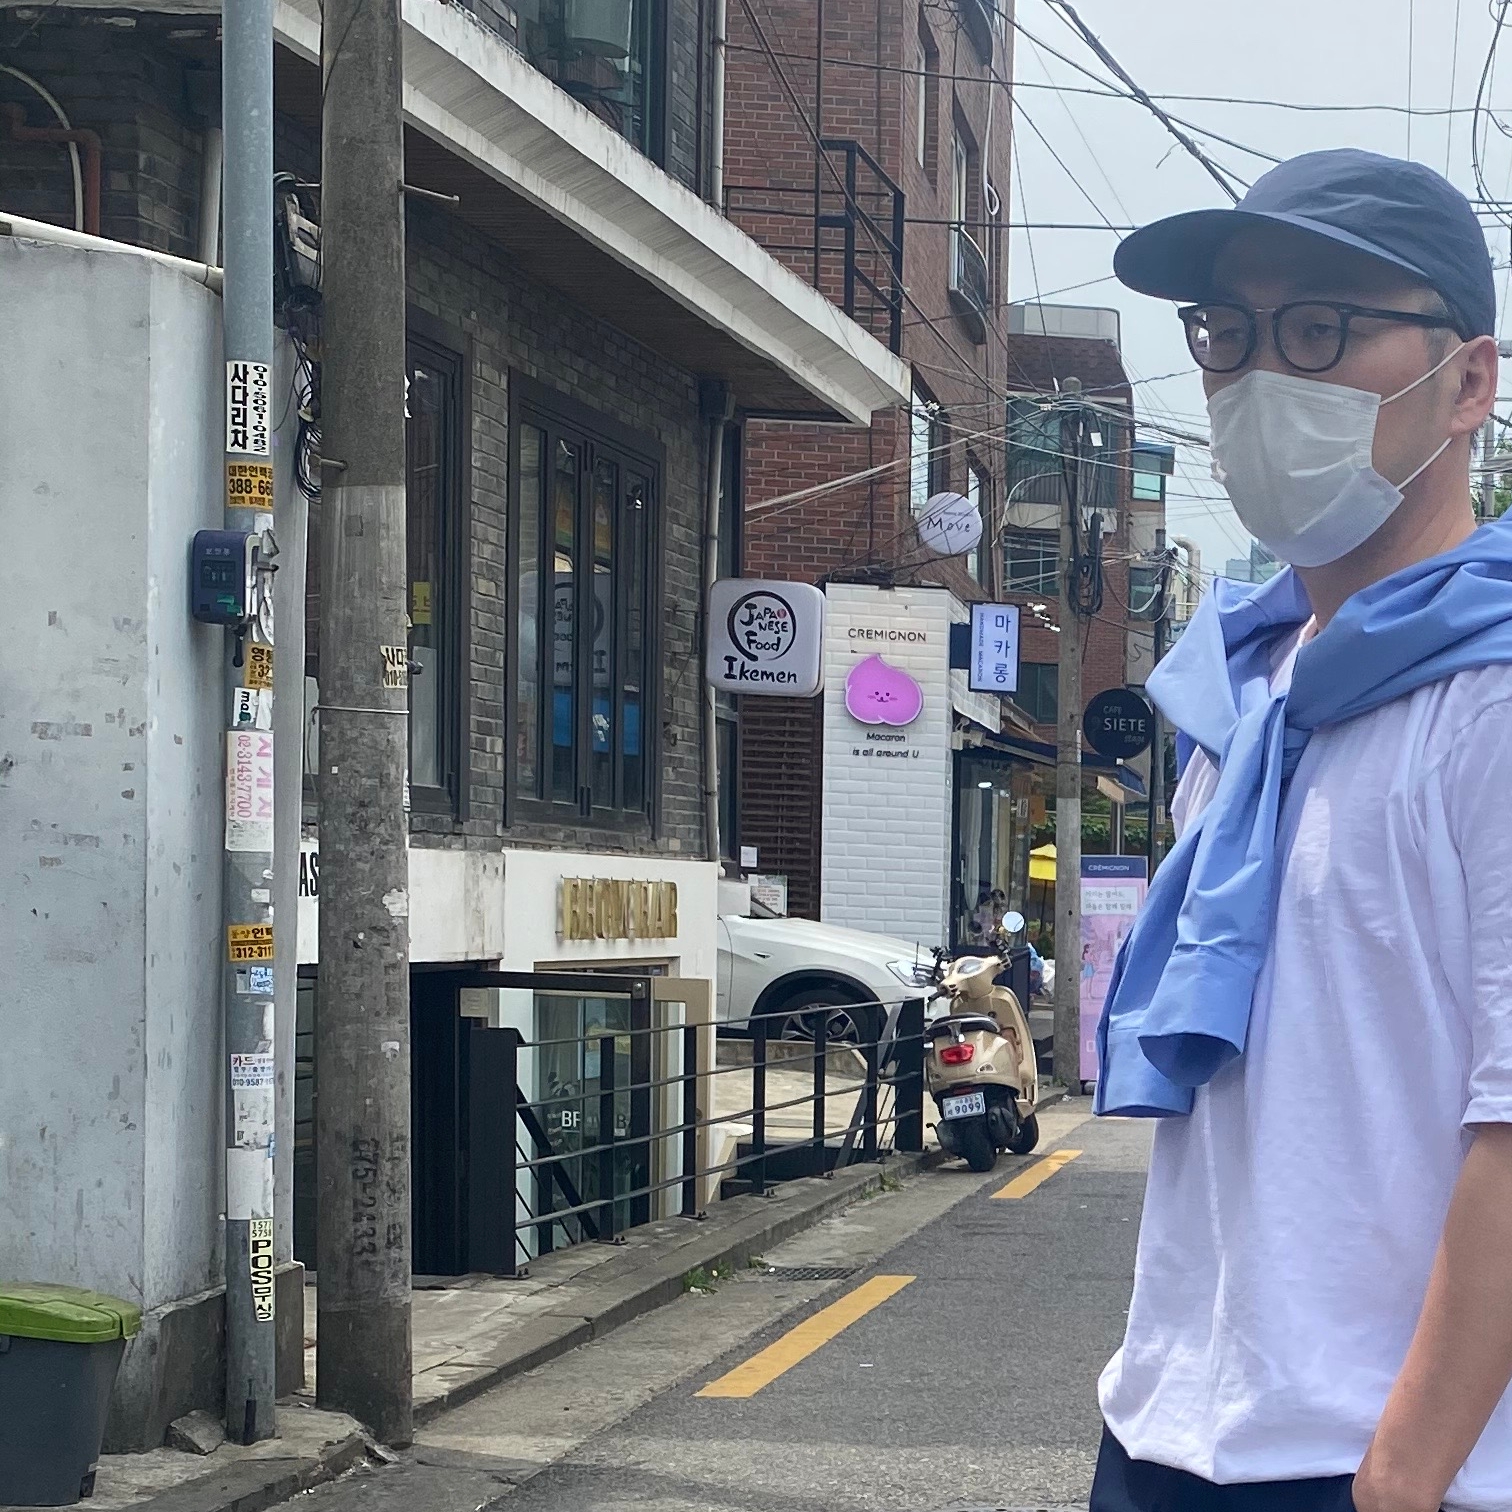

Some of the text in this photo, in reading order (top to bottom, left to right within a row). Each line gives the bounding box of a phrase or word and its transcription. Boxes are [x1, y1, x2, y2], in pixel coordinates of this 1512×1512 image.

[231, 364, 249, 450] 사다리차
[745, 630, 781, 652] Food
[993, 613, 1011, 683] 마카롱
[724, 655, 797, 683] Ikemen
[1103, 717, 1146, 733] SIETE
[866, 732, 906, 742] Macaron
[954, 1102, 981, 1115] 9099
